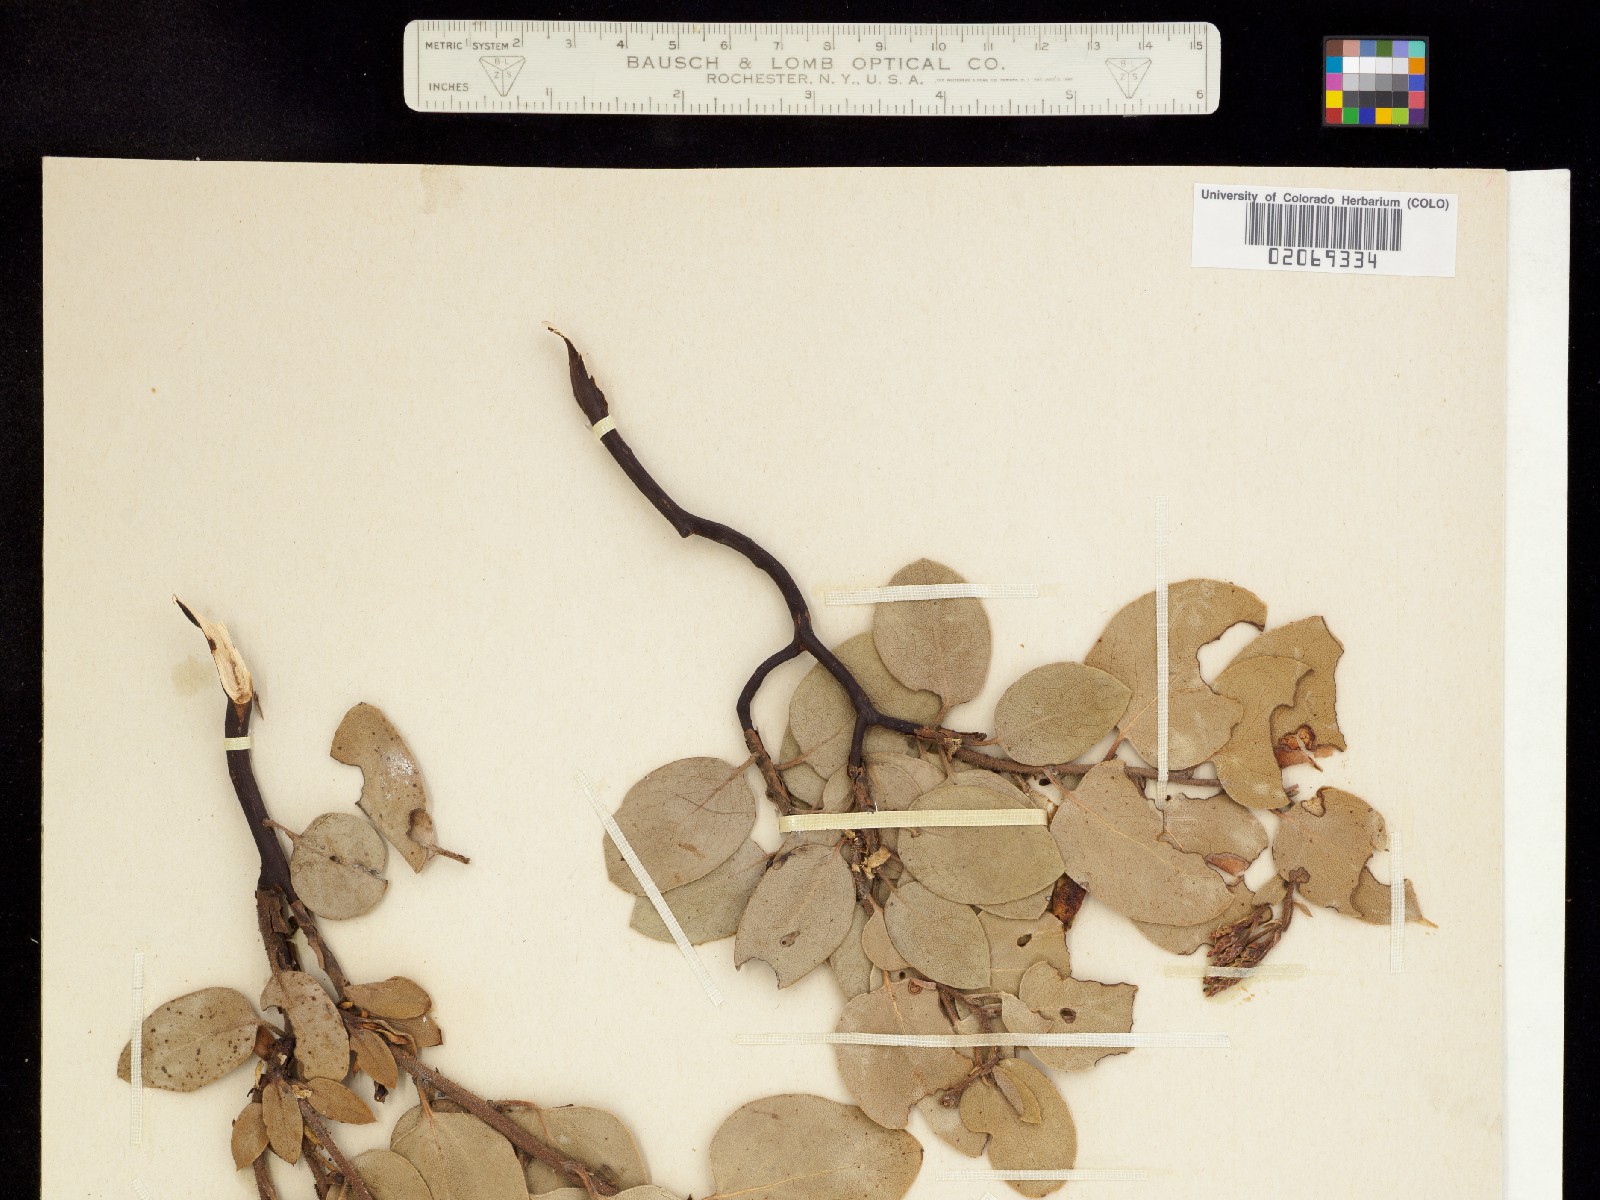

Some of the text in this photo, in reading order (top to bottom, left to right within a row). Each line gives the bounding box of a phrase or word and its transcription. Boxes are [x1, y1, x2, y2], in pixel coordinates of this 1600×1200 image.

[425, 41, 509, 51] METRIC SYSTEM
[512, 38, 521, 48] 2
[565, 39, 574, 49] 3
[616, 40, 626, 49] 4
[668, 40, 677, 50] 5
[720, 40, 728, 50] 6
[772, 40, 780, 51] 7
[823, 41, 832, 51] 8
[876, 41, 884, 51] 9
[627, 56, 1005, 71] BAUSCH & LOMB OPTICAL CO.
[428, 83, 469, 92] INCHES
[672, 90, 681, 99] 2
[935, 90, 944, 100] 4
[1196, 90, 1204, 99] 6
[1201, 189, 1449, 211] University of Colorado Herbarium (COLO)
[1268, 248, 1377, 269] 02069334
